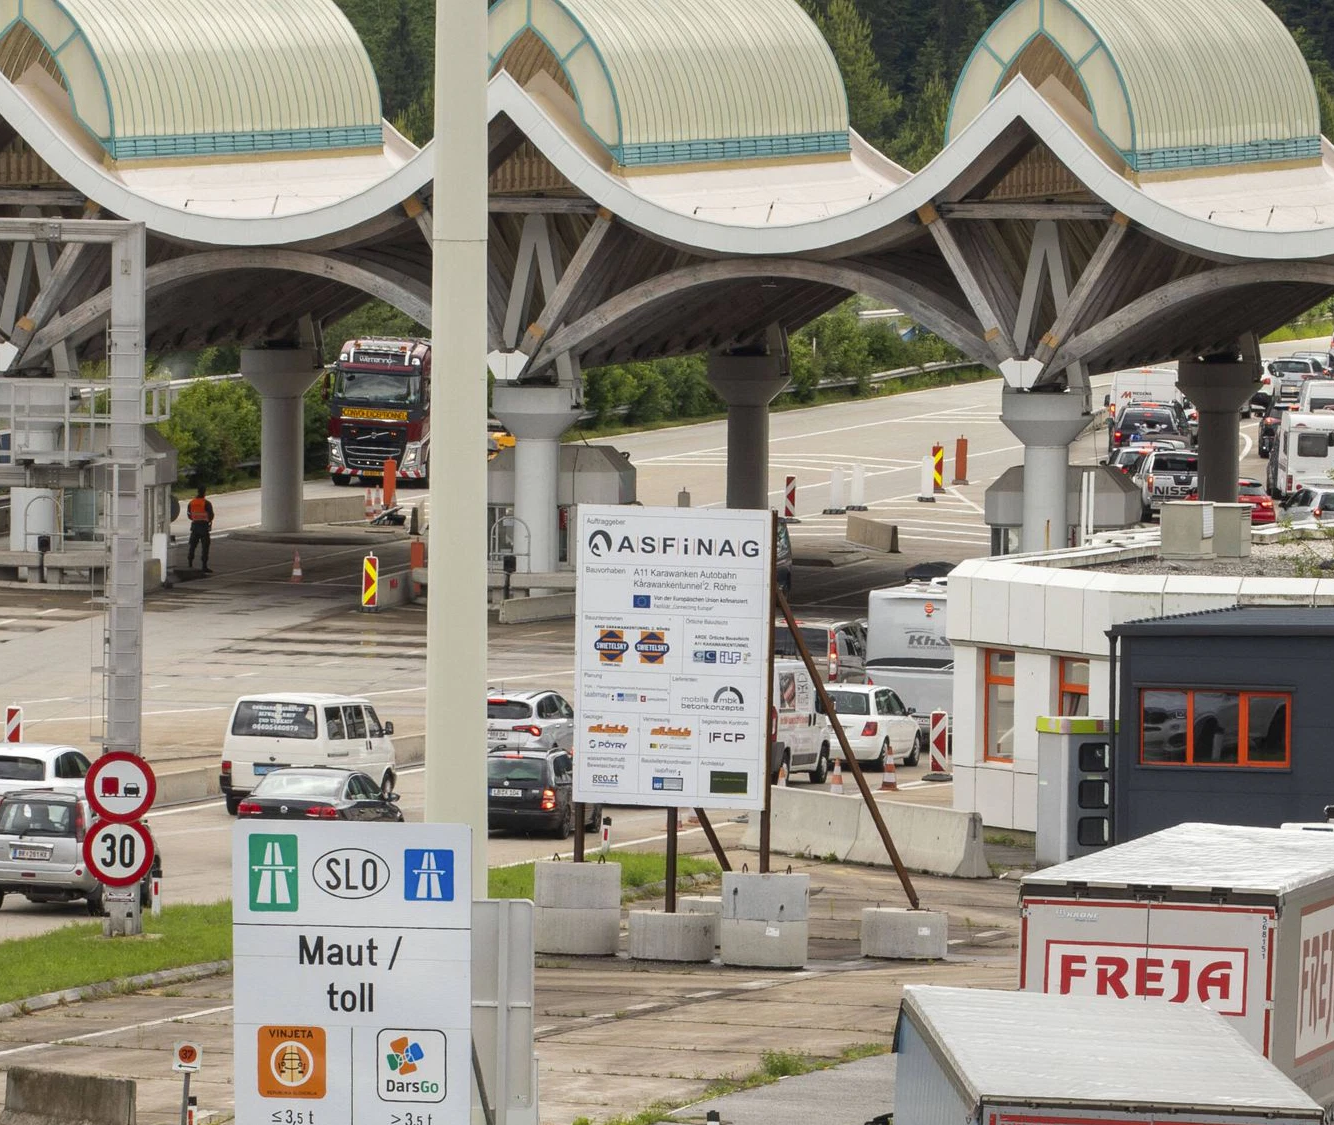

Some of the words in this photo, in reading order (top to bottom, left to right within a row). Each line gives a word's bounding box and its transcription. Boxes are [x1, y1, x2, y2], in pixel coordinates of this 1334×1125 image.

[634, 568, 648, 578] A11
[651, 569, 698, 580] Karawanken
[700, 571, 737, 581] Autobahn
[713, 582, 737, 593] Röhre
[596, 643, 627, 651] SWIETELSKY
[637, 644, 668, 652] SWIETELSKY
[681, 703, 745, 713] betonkonzepte
[100, 834, 136, 868] 30
[326, 858, 378, 891] SLO
[298, 935, 378, 966] Maut
[1061, 954, 1233, 1003] FREJA
[326, 982, 374, 1012] toll
[268, 1029, 314, 1039] VINJETA
[386, 1079, 439, 1093] DarsGo
[285, 1109, 303, 1125] 3,5
[309, 1111, 314, 1125] t
